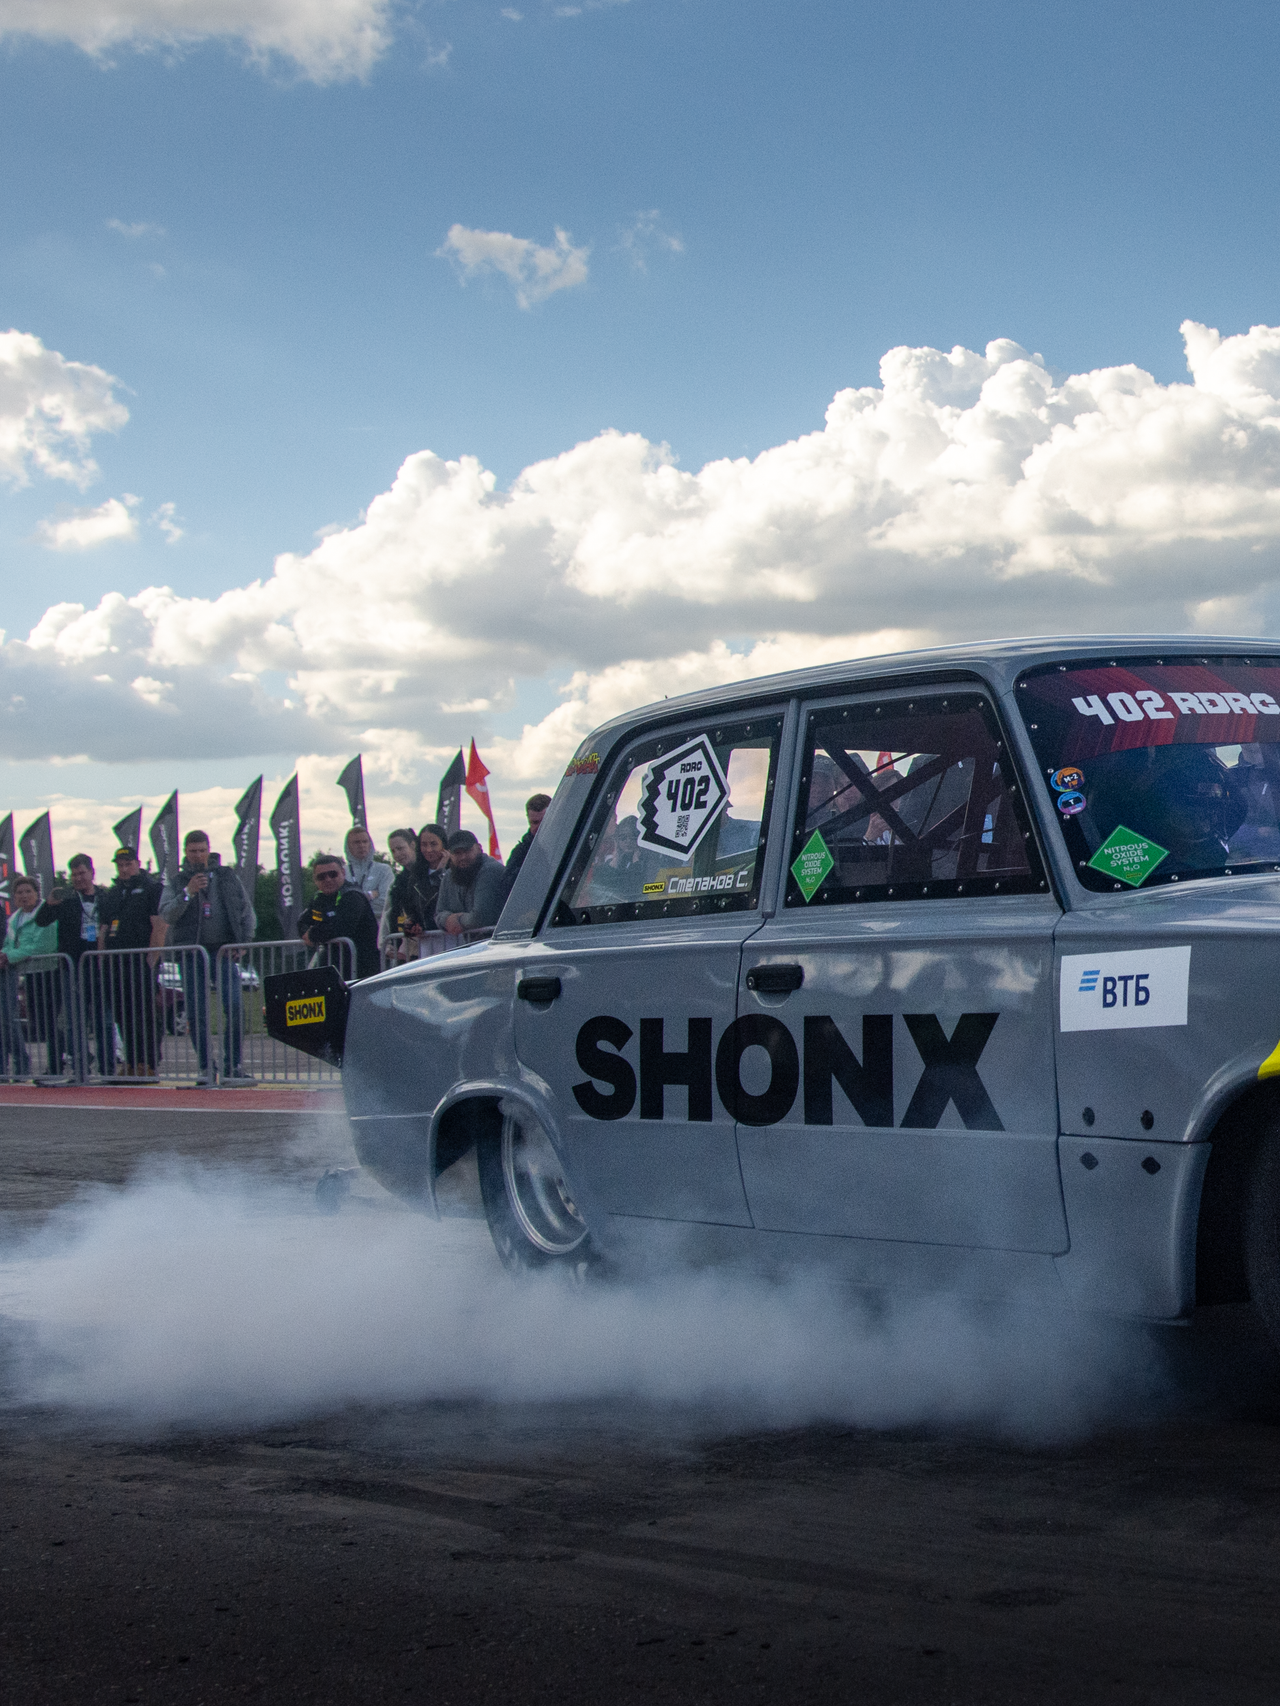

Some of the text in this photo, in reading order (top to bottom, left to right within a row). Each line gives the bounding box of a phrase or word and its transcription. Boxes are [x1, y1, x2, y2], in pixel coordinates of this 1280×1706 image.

[1071, 690, 1280, 725] 402 RDRC
[680, 761, 703, 773] RDRC
[666, 775, 711, 812] 402
[1103, 842, 1149, 855] NITROUS
[1112, 849, 1144, 860] OXIDE
[801, 851, 826, 861] NITROUS
[1110, 855, 1150, 867] SYSTEM
[804, 860, 821, 868] OXIDE
[801, 867, 822, 876] SYSTEM
[1102, 973, 1150, 1008] ВТБ
[287, 1001, 324, 1021] SHONX
[571, 1012, 1006, 1132] SHONX
